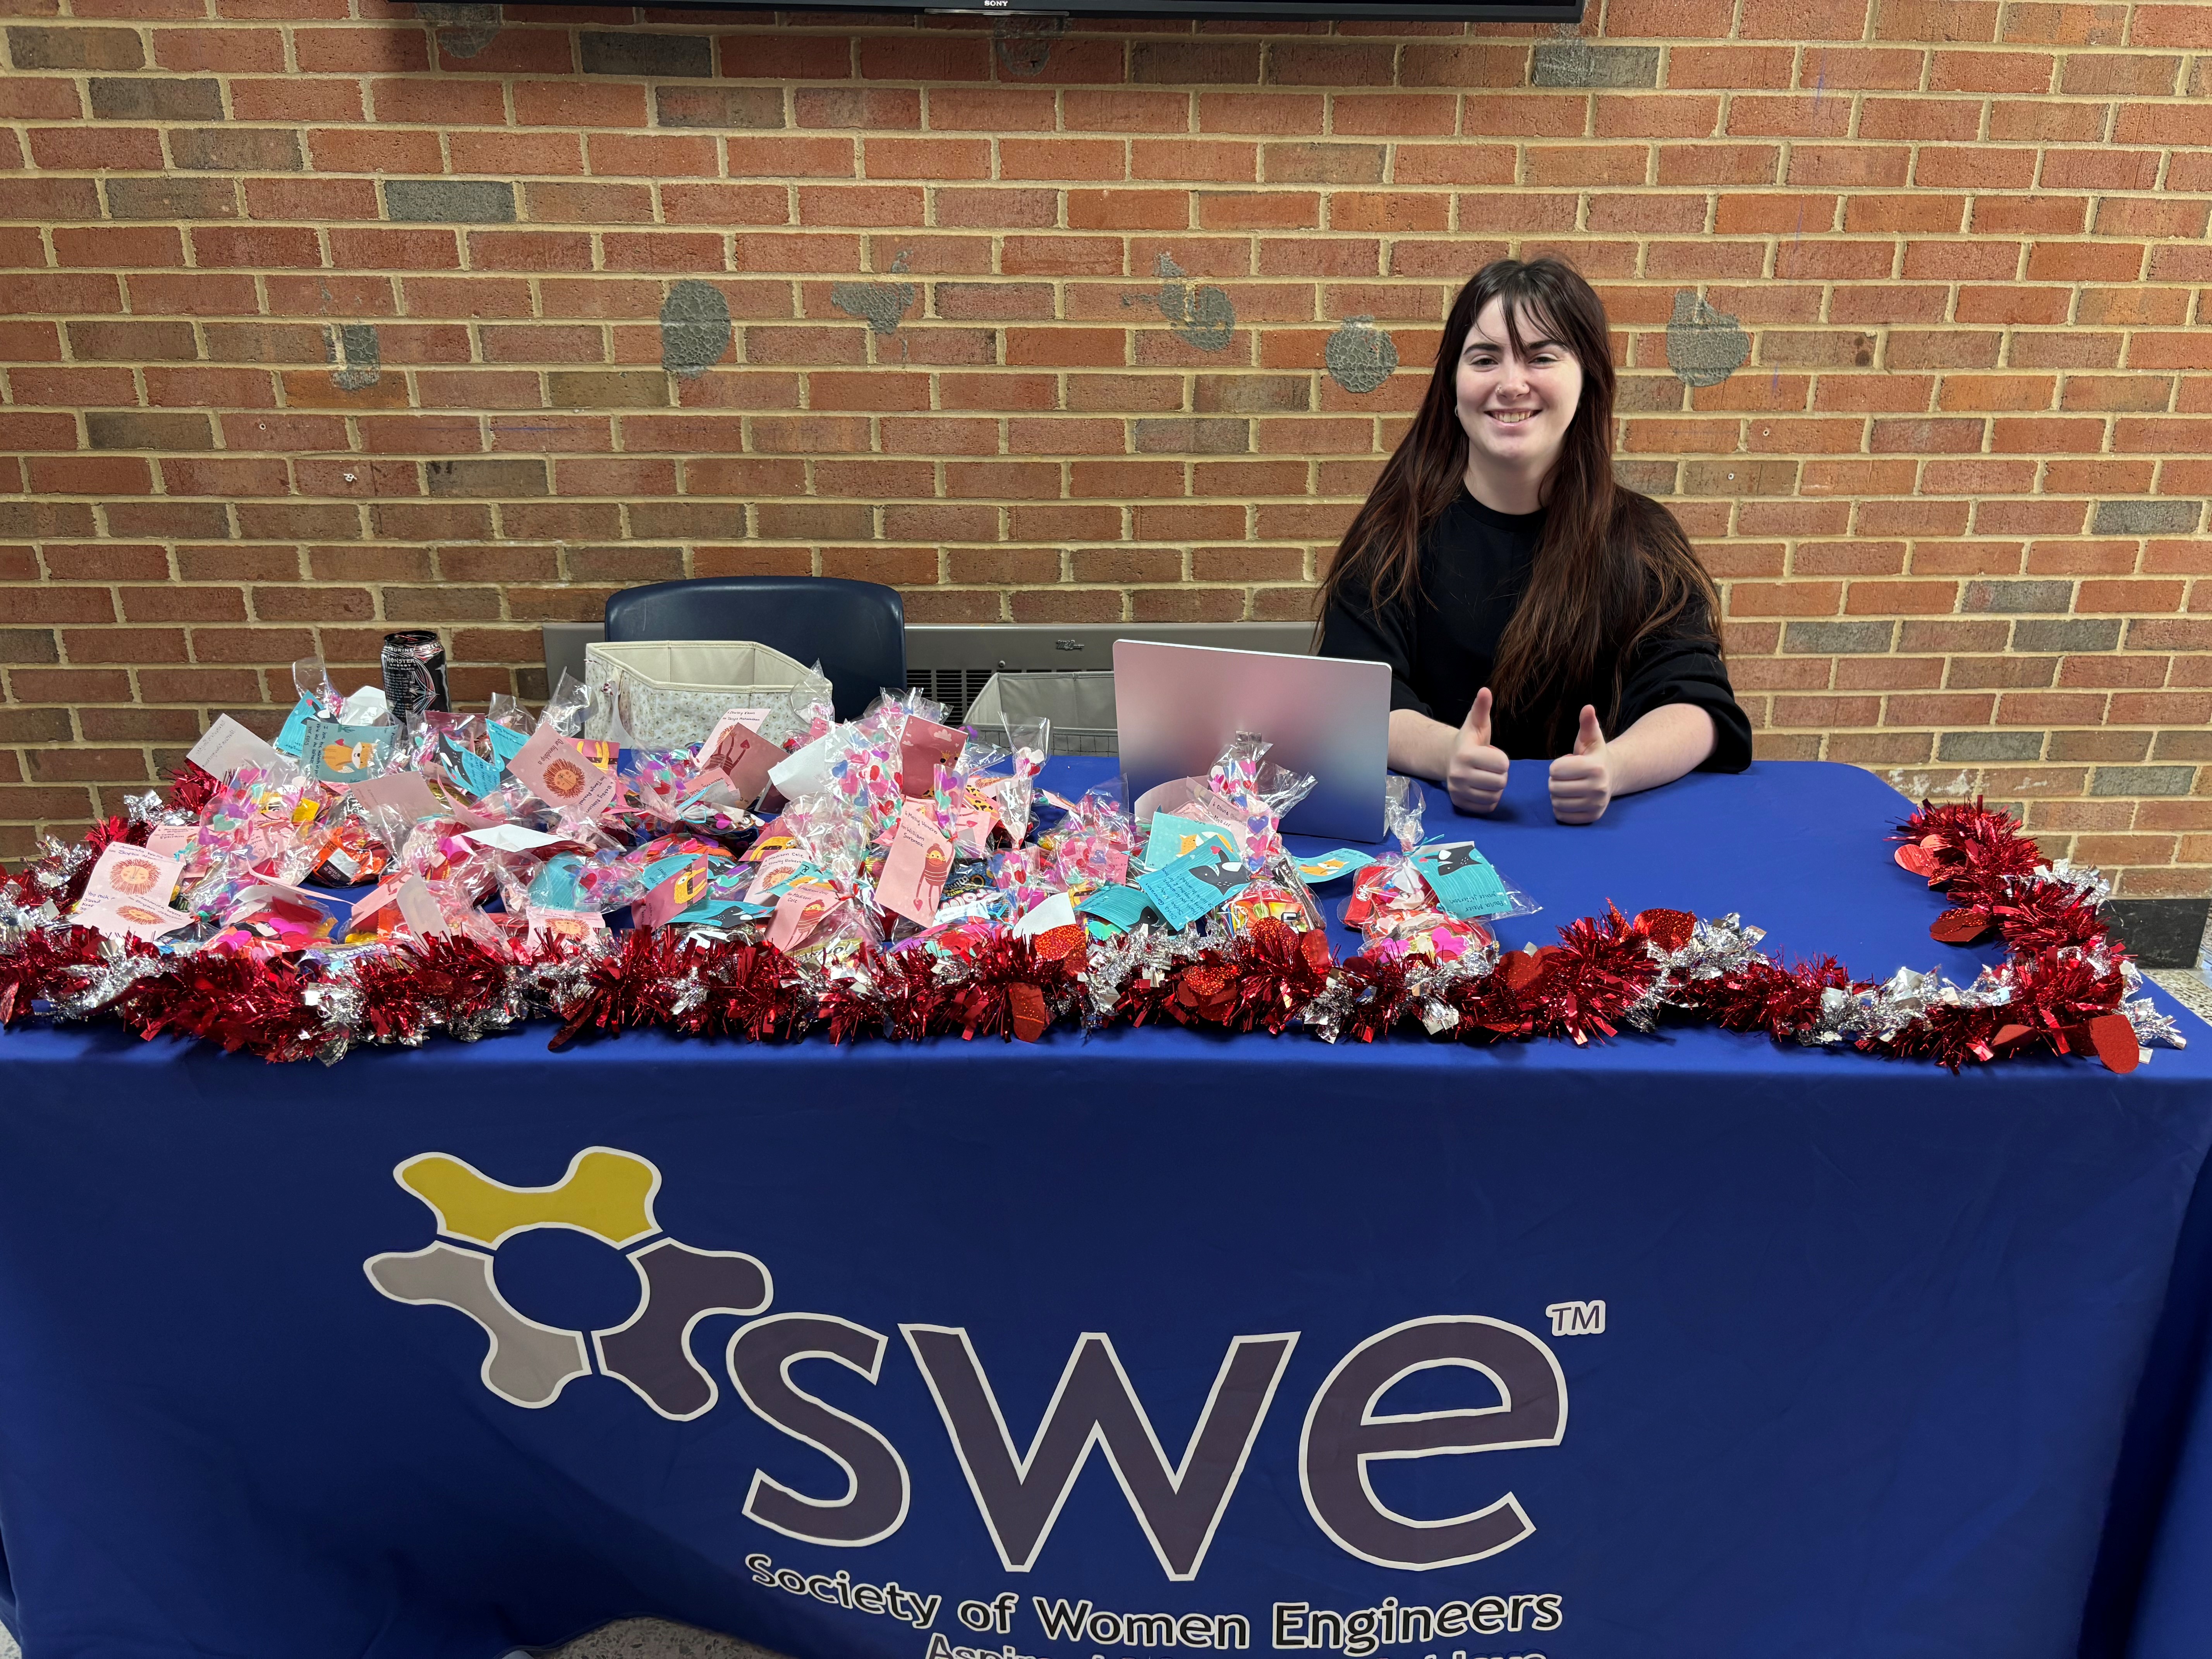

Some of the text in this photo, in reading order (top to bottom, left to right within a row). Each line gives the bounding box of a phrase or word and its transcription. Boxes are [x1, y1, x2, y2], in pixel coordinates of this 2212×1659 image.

[427, 642, 441, 650] ZERO
[542, 745, 558, 763] friendship
[597, 786, 612, 798] Betsy
[586, 799, 601, 814] Nation
[1216, 804, 1229, 816] Olivia
[907, 827, 924, 841] William
[1449, 894, 1477, 904] Jefferson
[726, 1313, 1568, 1582] swe
[745, 1554, 942, 1629] Society
[957, 1592, 1019, 1633] of
[1033, 1596, 1250, 1649] Women
[1273, 1593, 1563, 1657] Engineers
